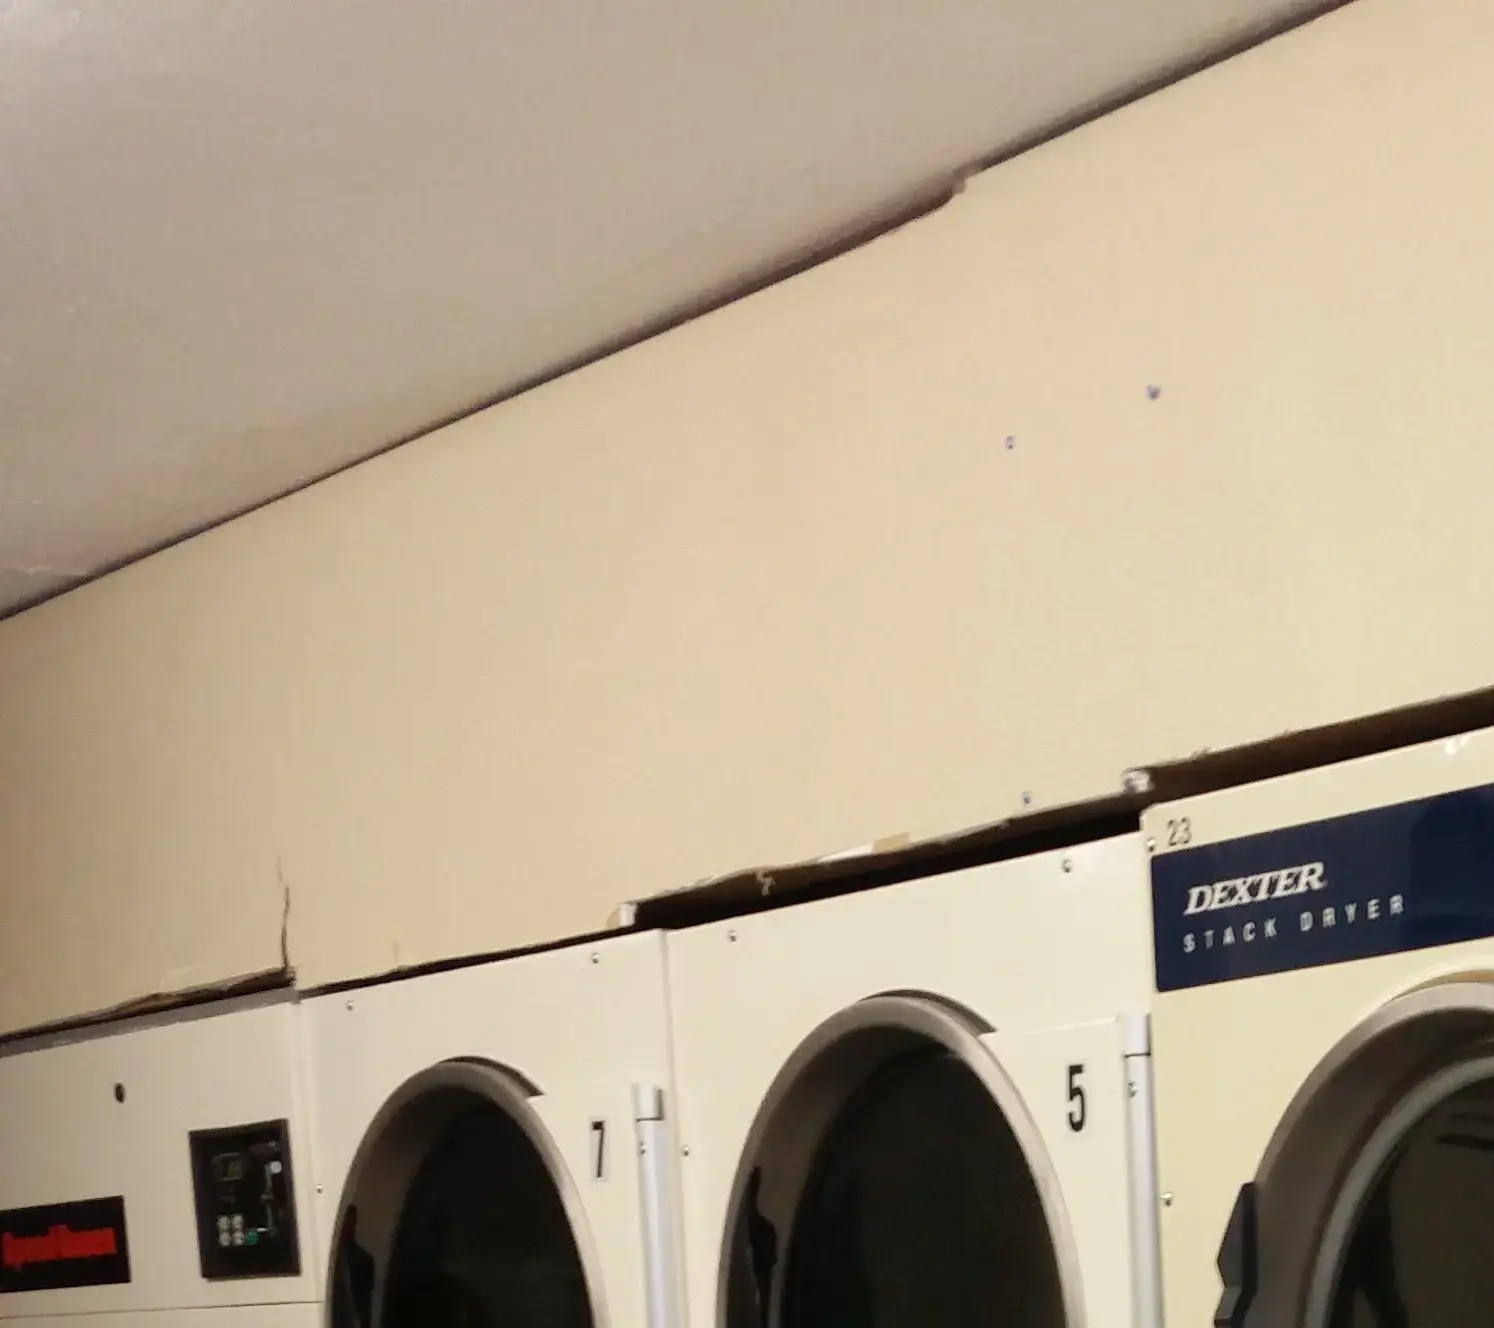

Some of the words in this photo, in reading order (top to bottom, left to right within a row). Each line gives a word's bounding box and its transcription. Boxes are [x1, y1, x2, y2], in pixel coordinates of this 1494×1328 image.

[1167, 816, 1193, 847] 23
[1183, 861, 1328, 916] DEXTER
[1183, 917, 1278, 954] STACK
[1299, 894, 1405, 933] DRYER
[1067, 1064, 1087, 1132] 5
[592, 1120, 606, 1178] 7
